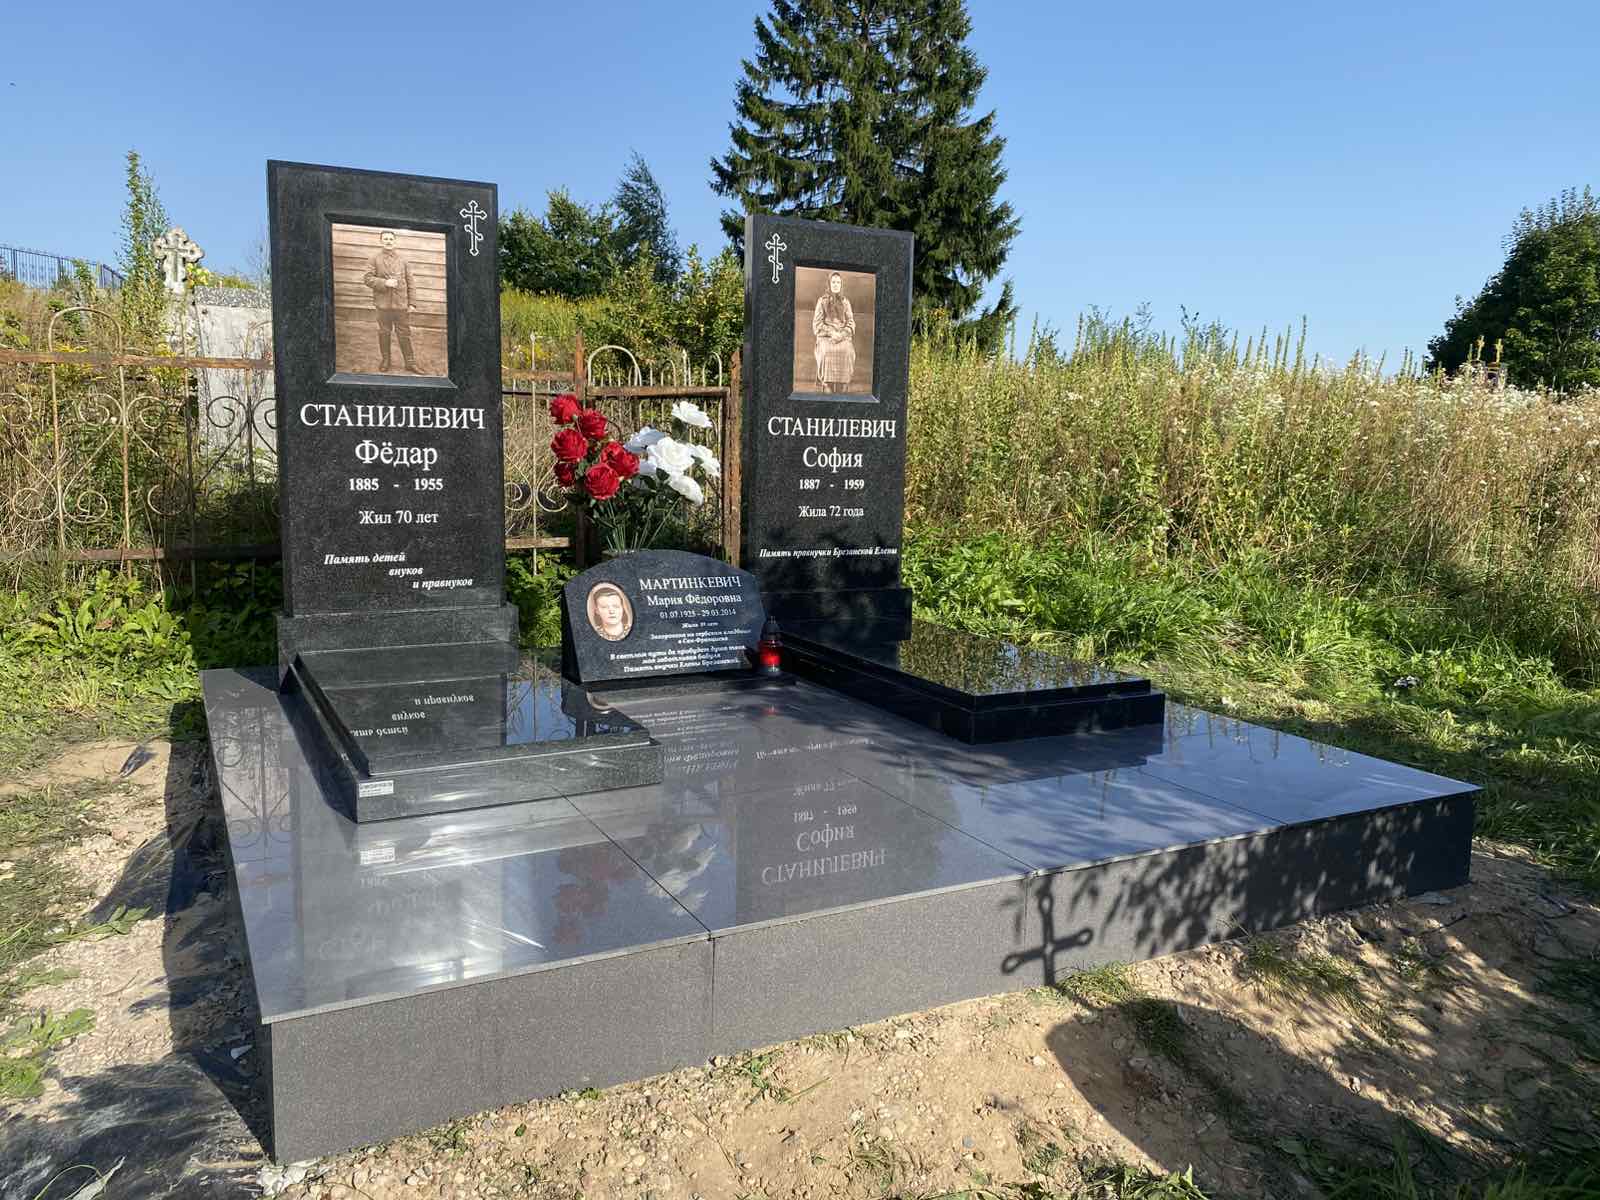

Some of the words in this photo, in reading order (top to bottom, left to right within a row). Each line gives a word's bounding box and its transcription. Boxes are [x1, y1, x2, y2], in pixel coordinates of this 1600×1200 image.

[300, 404, 486, 430] СТАНИЛЕВИЧ
[767, 416, 898, 439] СТАНИЛЕВИЧ
[355, 440, 438, 471] Фёдар
[803, 446, 863, 473] София
[349, 478, 380, 491] 1885
[414, 478, 444, 491] 1955
[799, 479, 821, 490] 1887
[844, 479, 865, 491] 1959
[359, 510, 392, 525] Жил
[396, 510, 412, 524] 70
[416, 512, 439, 524] лет
[798, 505, 827, 518] Жила
[830, 505, 841, 517] 72
[843, 507, 864, 518] года
[324, 554, 370, 566] Память
[372, 552, 406, 564] детей
[759, 548, 791, 558] Память
[388, 567, 424, 576] внуков
[412, 580, 420, 589] и
[422, 577, 473, 591] правнуков
[639, 576, 743, 591] МАРТИНКЕВИЧ
[647, 596, 683, 608] Мария
[685, 593, 743, 606] Фёдоровна
